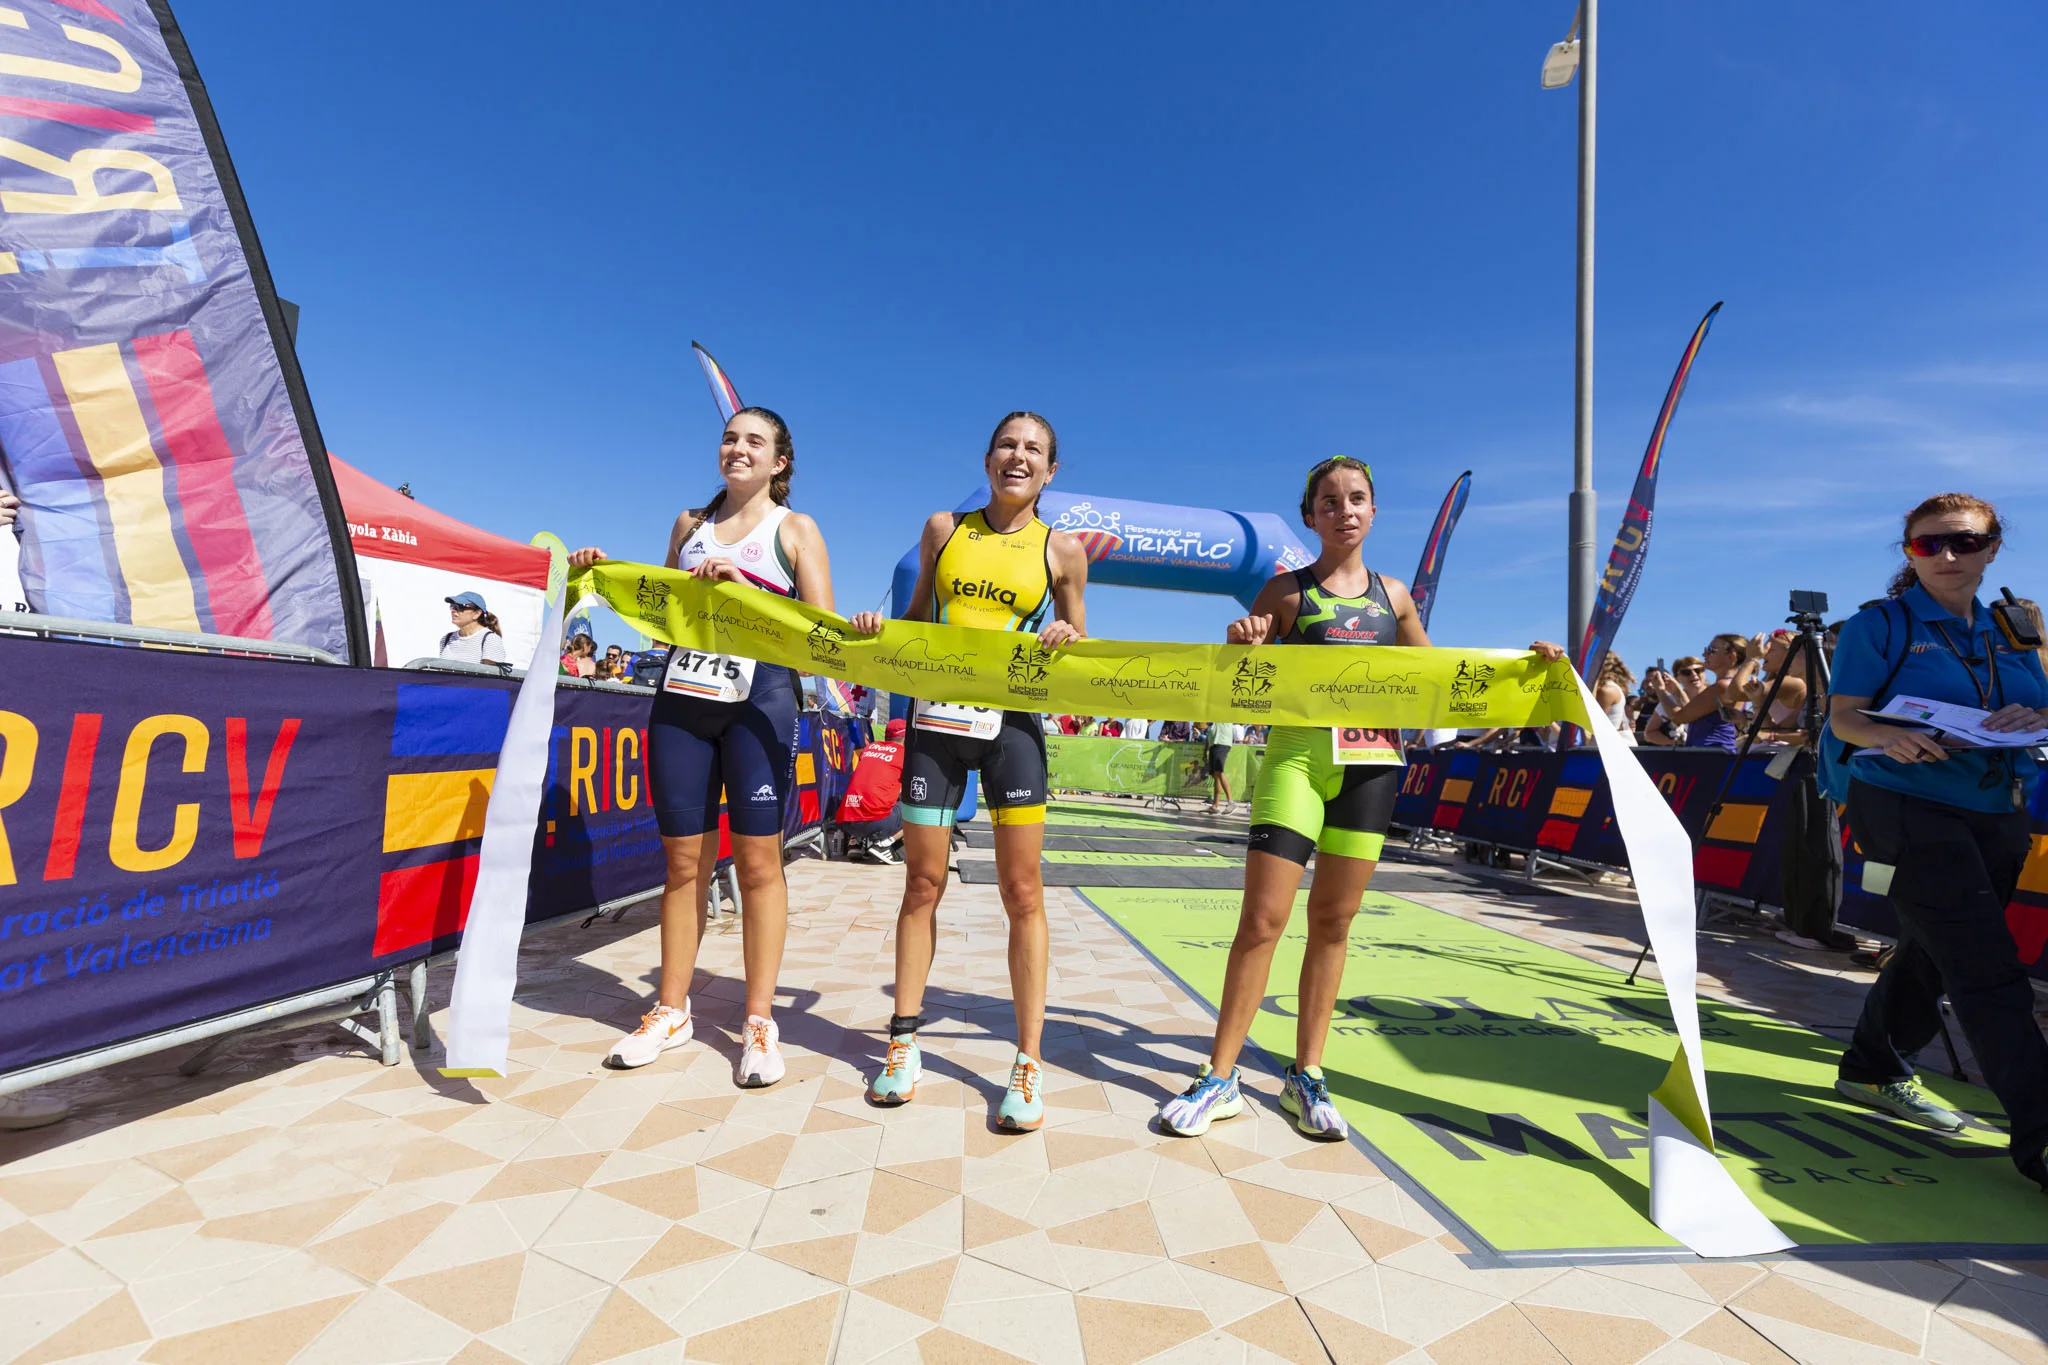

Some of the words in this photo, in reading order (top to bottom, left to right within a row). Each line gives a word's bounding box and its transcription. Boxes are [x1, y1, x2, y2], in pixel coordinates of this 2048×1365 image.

[381, 525, 418, 546] Xàbia
[1124, 533, 1236, 560] TRIATLÓ
[1108, 553, 1167, 565] COMUNITAT
[952, 578, 1017, 606] teika
[677, 652, 741, 680] 4715
[873, 655, 945, 673] GRANADELLA
[946, 664, 977, 676] TRAIL
[1008, 683, 1048, 696] Llebeig
[1090, 676, 1168, 690] GRANADELLA
[1169, 680, 1201, 691] TRAIL
[1309, 683, 1387, 695] GRANADELLA
[1388, 684, 1420, 695] TRAIL
[1231, 697, 1272, 709] Llebeig
[1449, 701, 1488, 712] Llebeig
[868, 743, 898, 753] CRONO
[1006, 789, 1032, 799] teika
[120, 888, 166, 922] de
[177, 869, 280, 912] Triatló
[64, 917, 273, 979] Valenciana
[1332, 1023, 1431, 1037] más
[1436, 1023, 1518, 1037] allá
[1517, 1024, 1579, 1037] de
[1571, 1024, 1623, 1038] la
[1746, 1166, 1940, 1186] BAGS
